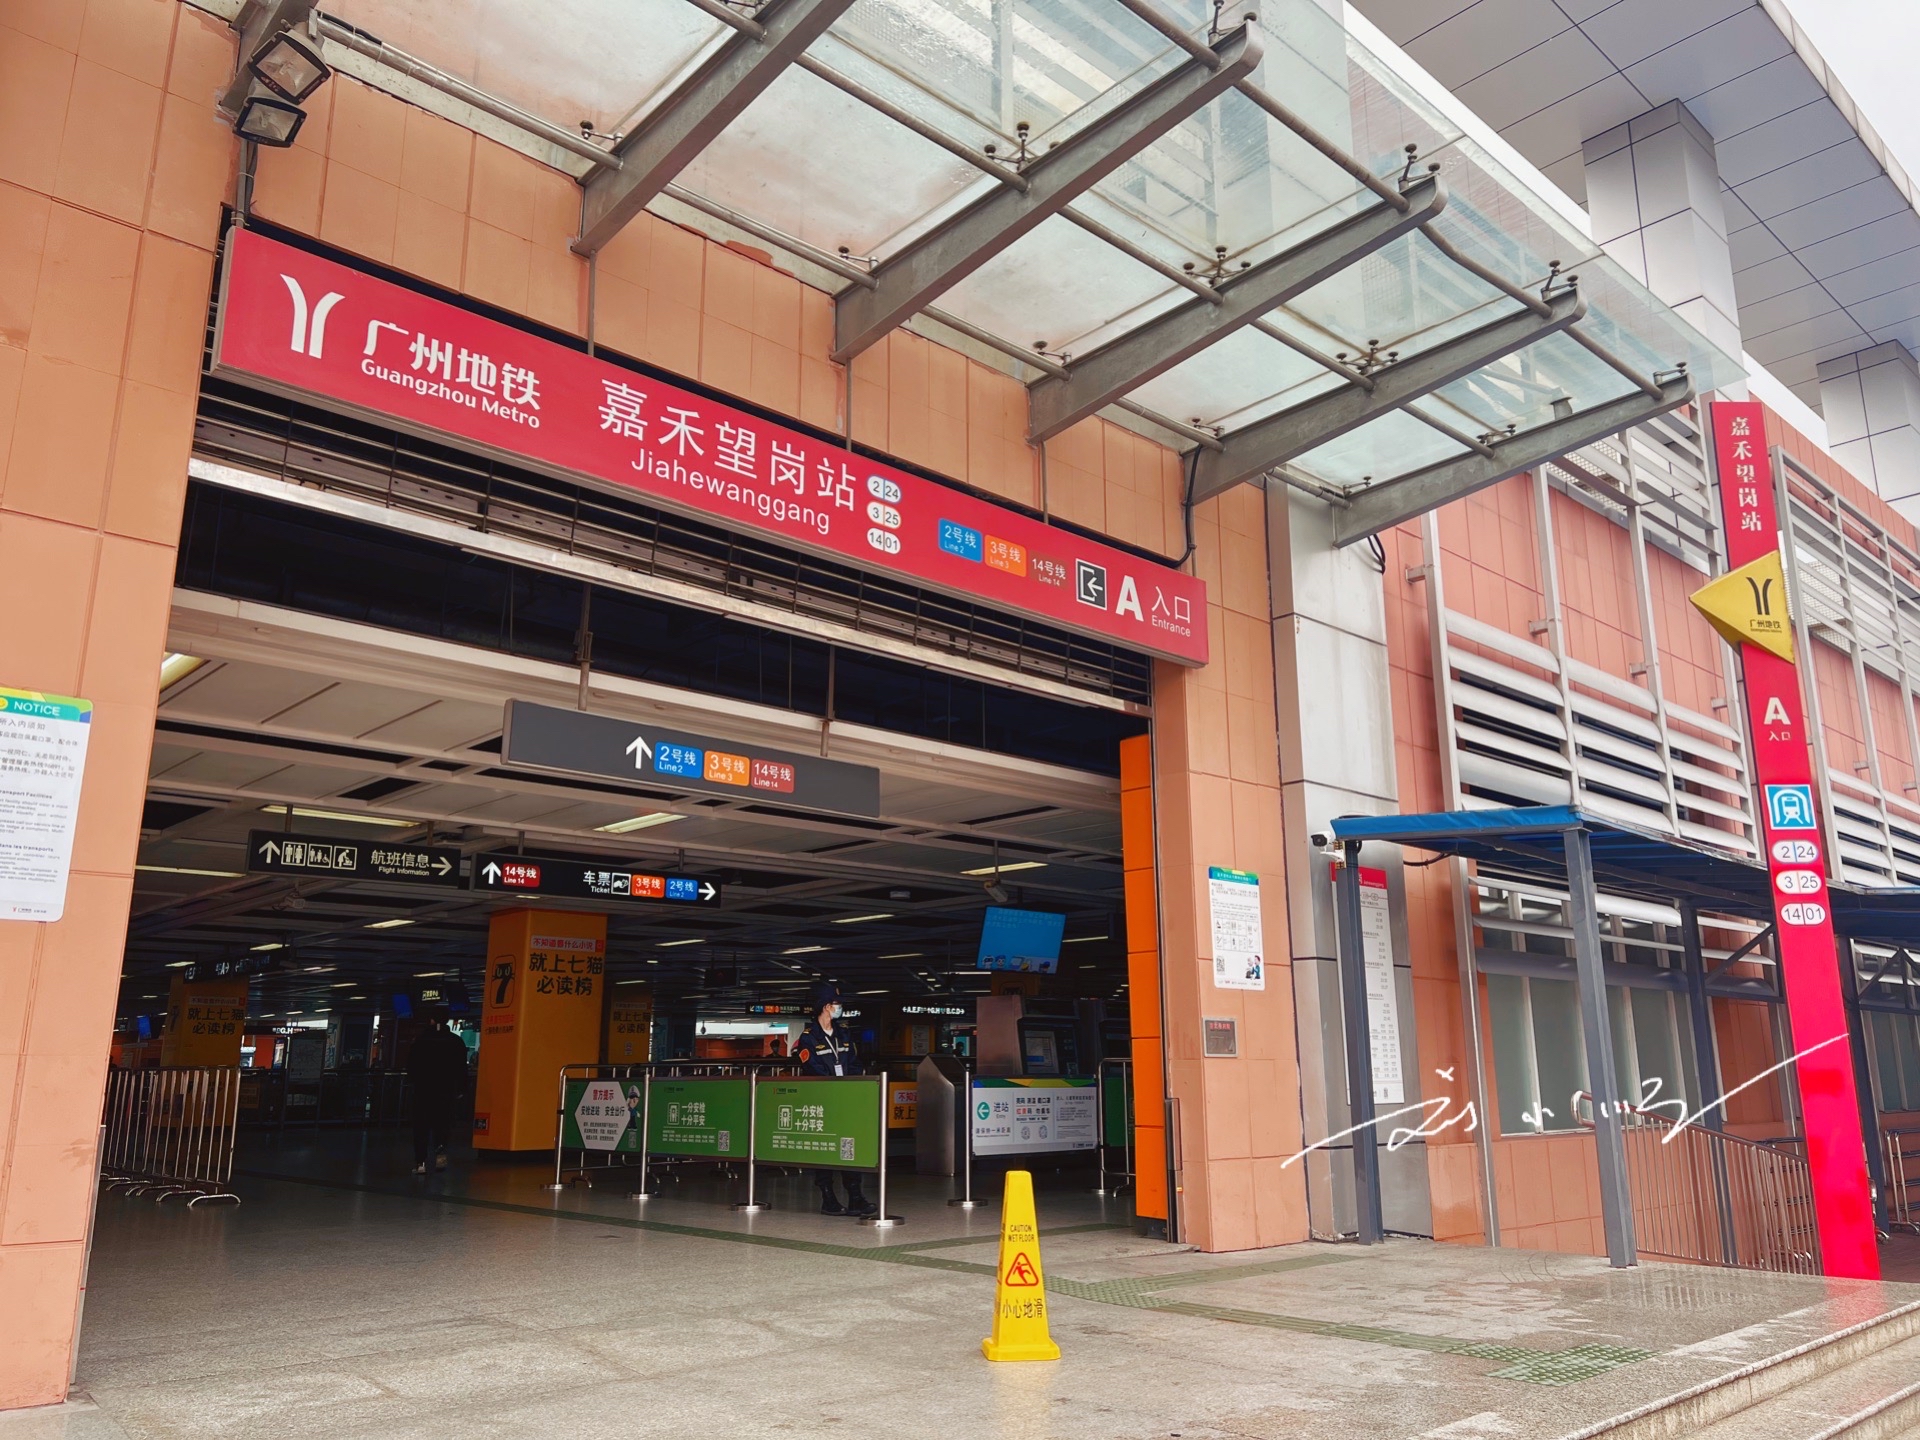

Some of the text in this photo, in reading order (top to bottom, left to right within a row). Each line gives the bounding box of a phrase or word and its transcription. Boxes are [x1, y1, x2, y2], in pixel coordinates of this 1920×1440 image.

[362, 318, 541, 411] 广州地铁
[360, 358, 541, 430] Guangzhou Metro
[598, 378, 857, 512] 嘉禾望岗站
[1730, 416, 1763, 533] 嘉禾望岗站
[631, 447, 830, 535] Jiahewanggang
[944, 524, 977, 549] 2号线
[990, 541, 1022, 564] 3号线
[1031, 557, 1067, 581] 14号线
[1115, 574, 1145, 623] A
[1151, 585, 1191, 625] 入口
[1151, 615, 1192, 638] Entrance
[1749, 618, 1782, 629] 广州地铁
[13, 701, 62, 717] NOTICE
[1763, 696, 1792, 726] A
[1768, 731, 1791, 742] 入口
[659, 745, 697, 767] 2号线
[709, 754, 746, 774] 3号线
[754, 762, 791, 782] 14号线
[370, 849, 430, 869] 航班信息
[378, 866, 430, 877] Flight Information
[504, 866, 537, 880] 14号线
[583, 870, 611, 887] 车票
[591, 886, 611, 894] Ticket
[635, 877, 661, 889] 3号线
[669, 881, 695, 893] 2号线
[528, 952, 603, 975] 就上七猫
[536, 975, 593, 996] 必读榜
[794, 1104, 824, 1118] 一分安检
[993, 1101, 1009, 1113] 进站
[794, 1118, 824, 1132] 十分平安
[1007, 1233, 1035, 1243] WET FLOOR
[1009, 1224, 1032, 1233] CAUTION
[1001, 1297, 1043, 1319] 小心地滑
